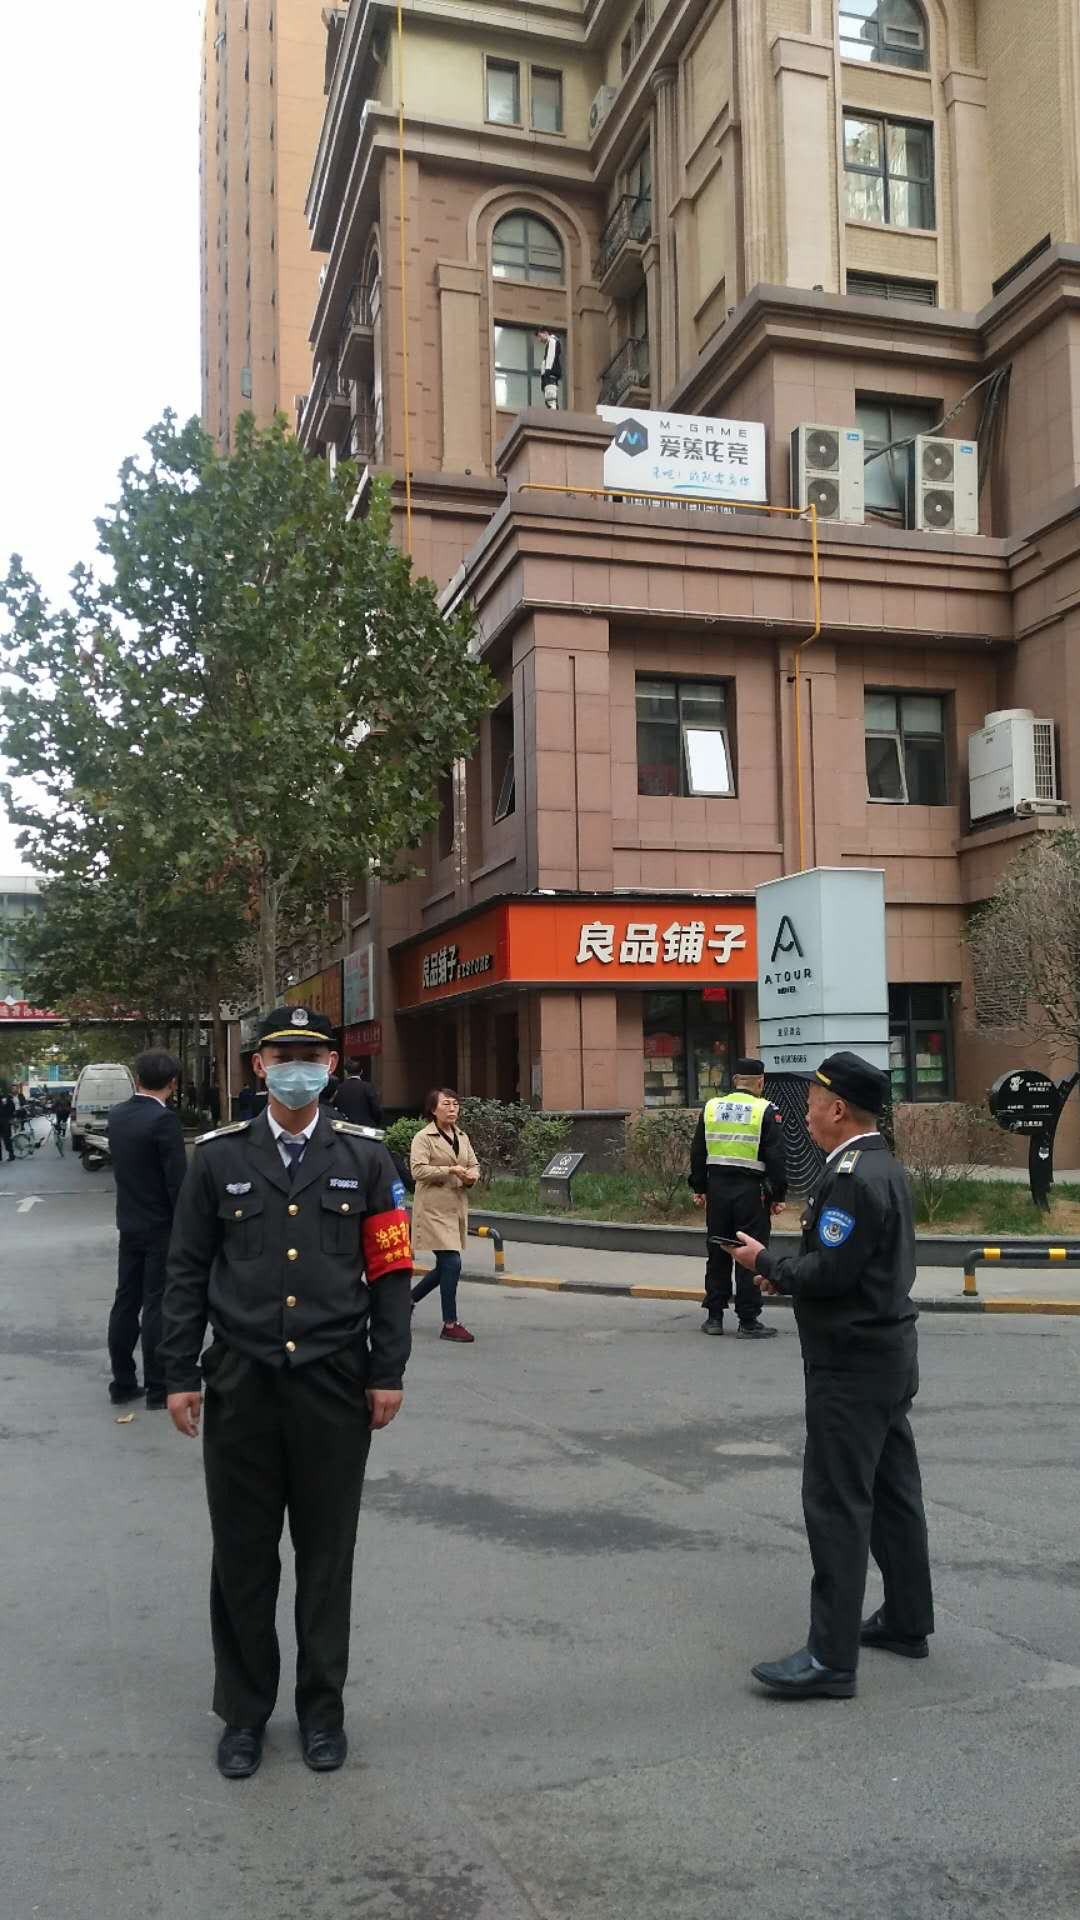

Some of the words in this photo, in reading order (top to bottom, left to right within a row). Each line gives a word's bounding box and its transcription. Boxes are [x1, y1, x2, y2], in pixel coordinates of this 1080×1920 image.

[576, 920, 747, 965] 良品铺子
[765, 968, 812, 985] ATOUR
